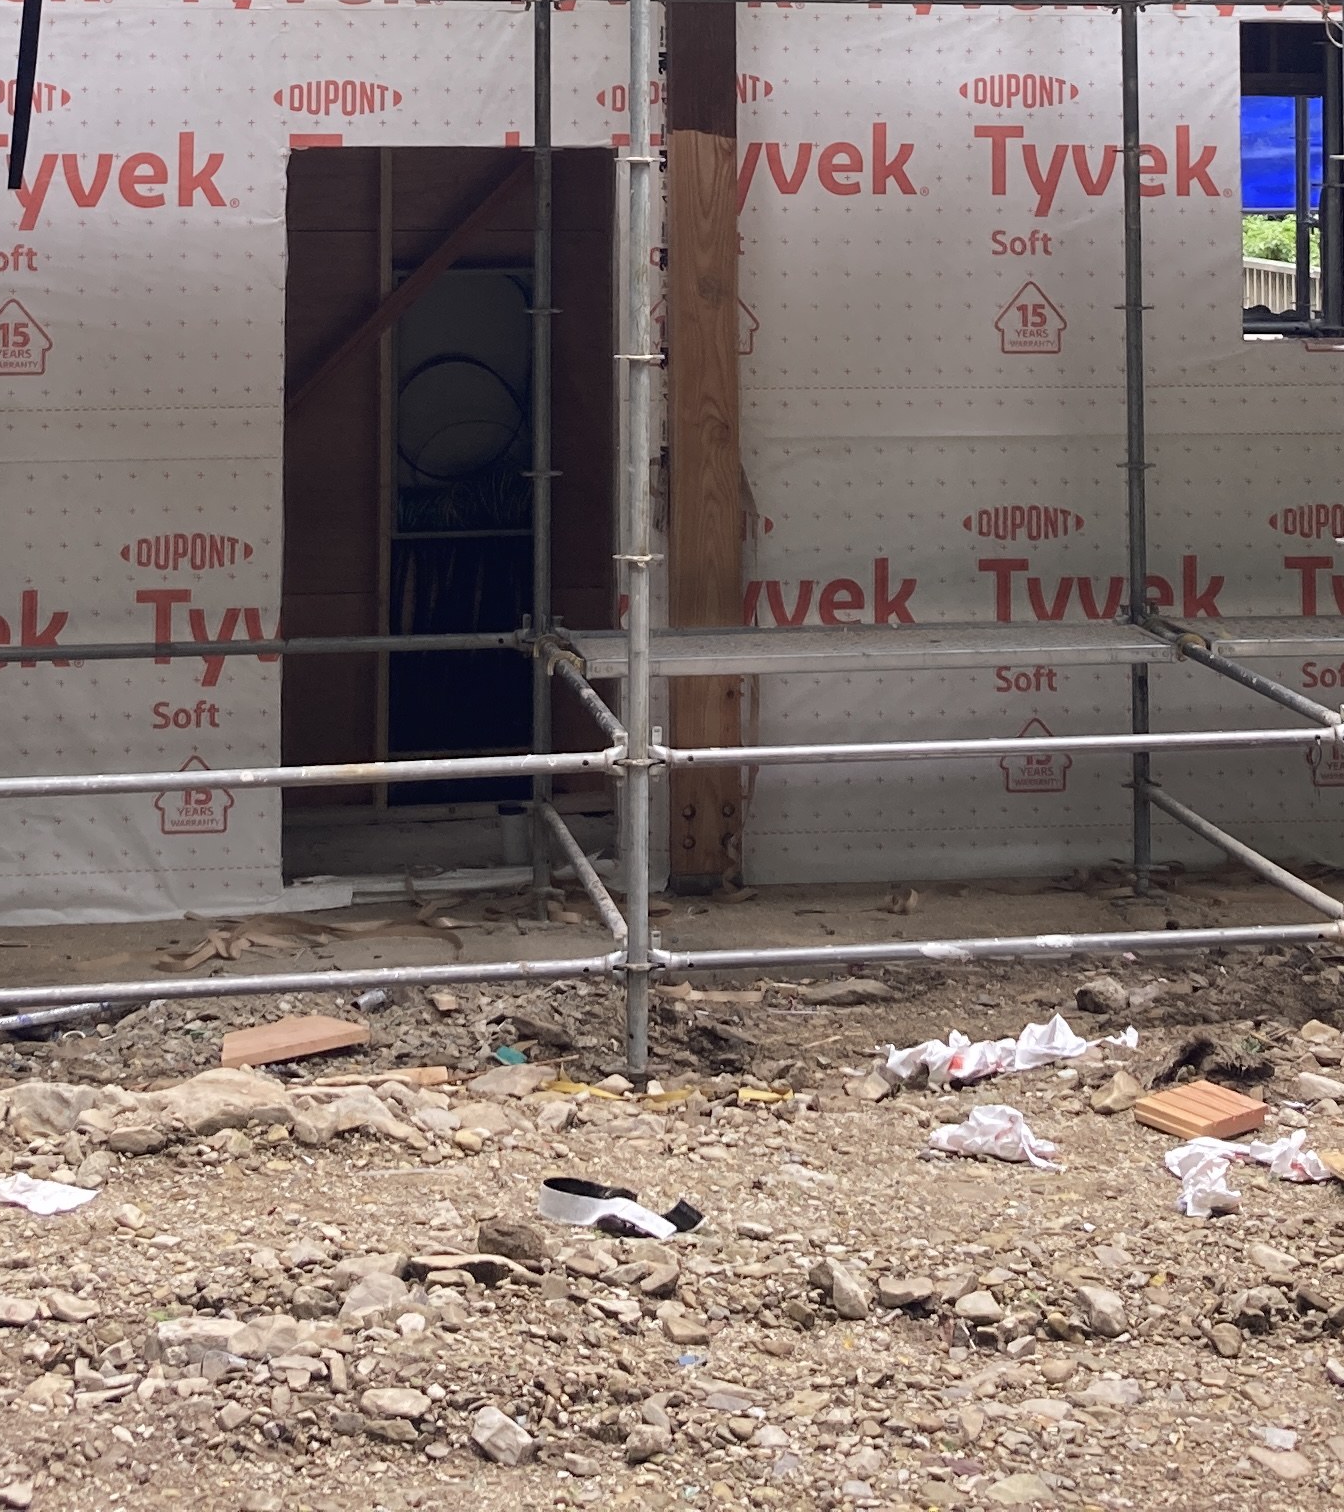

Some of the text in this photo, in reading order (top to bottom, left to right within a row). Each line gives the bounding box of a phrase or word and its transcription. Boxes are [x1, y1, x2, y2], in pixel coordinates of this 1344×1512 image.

[290, 79, 388, 116] DUPONT
[974, 73, 1066, 109] DUPONT
[974, 122, 1220, 218] Tyvek
[991, 229, 1053, 256] Soft
[1016, 303, 1047, 328] 15
[1015, 328, 1049, 338] YEARS
[977, 505, 1071, 541] DUPONT
[137, 533, 239, 571] DUPONT
[136, 589, 282, 687] Tyv
[996, 666, 1057, 692] Soft
[152, 701, 220, 729] Soft
[1020, 767, 1054, 777] YEARS
[176, 807, 215, 817] YEARS
